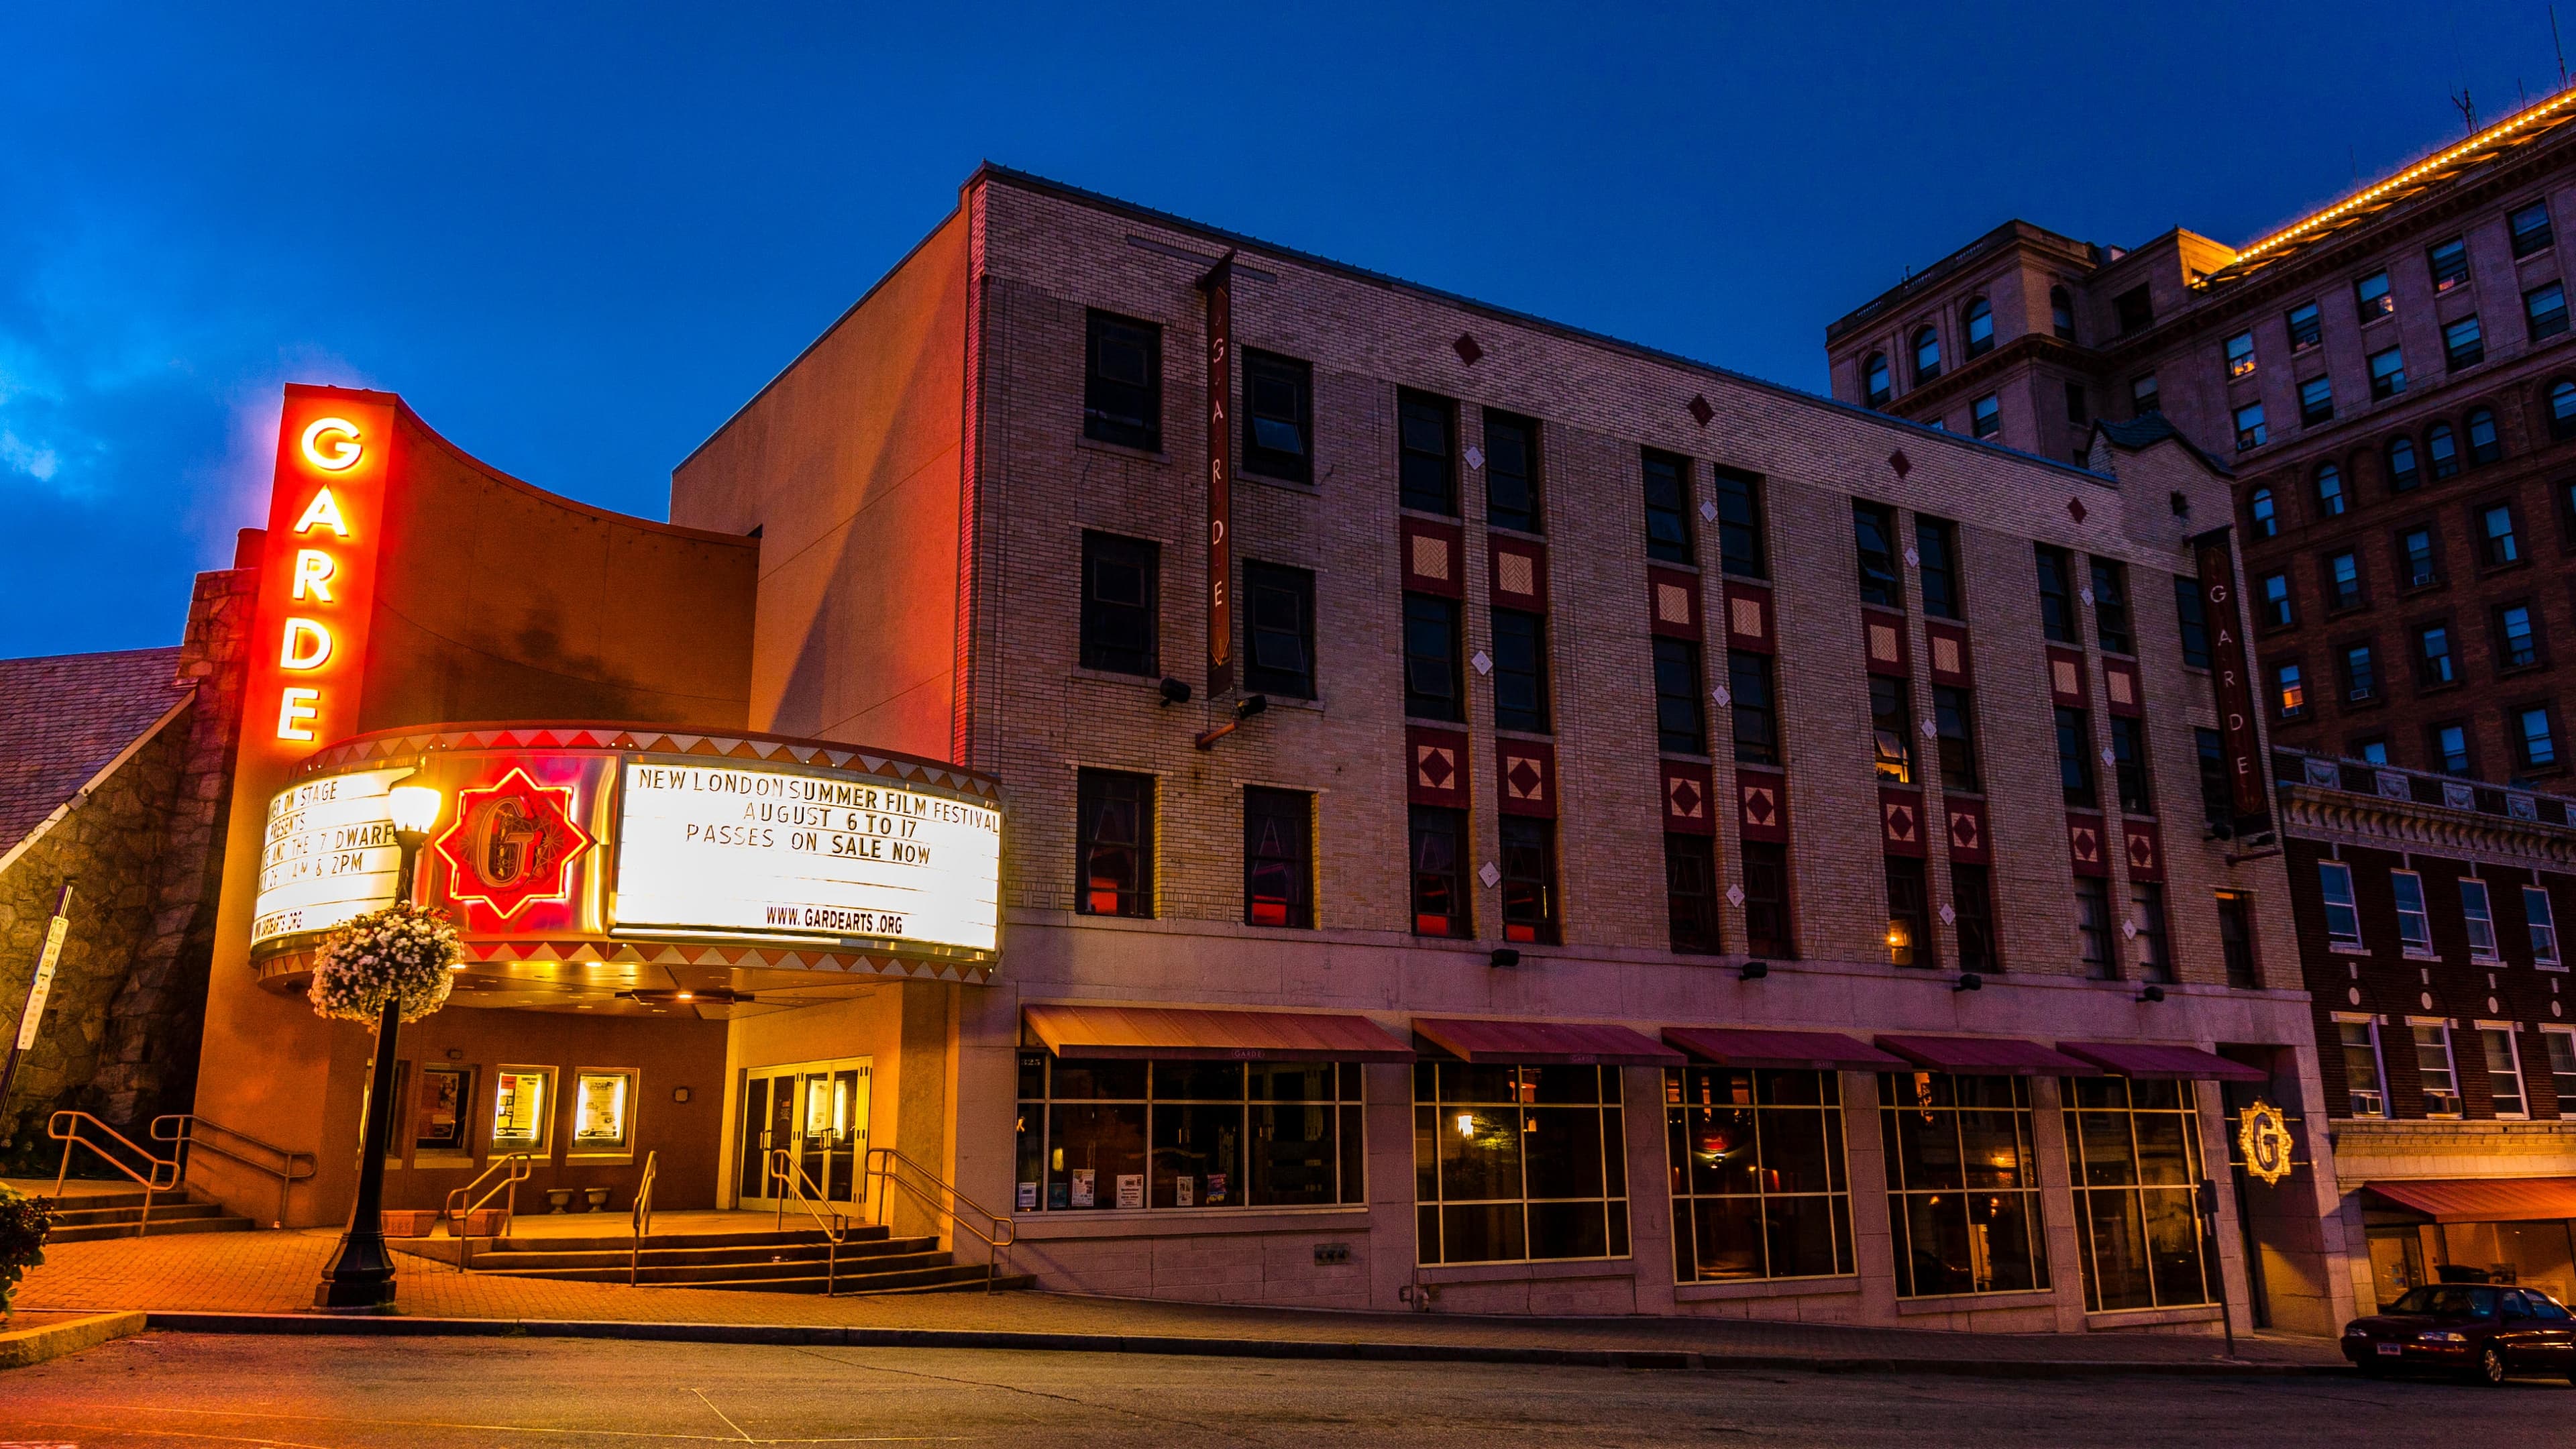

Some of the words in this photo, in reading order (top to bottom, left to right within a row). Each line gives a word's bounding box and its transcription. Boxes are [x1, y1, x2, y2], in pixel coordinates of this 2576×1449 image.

[1212, 337, 1224, 608] GARDE
[276, 417, 362, 742] GARDE
[2210, 585, 2249, 775] GARDE
[301, 781, 337, 806] STAGE
[639, 769, 686, 790] NEW
[694, 771, 784, 797] LONDON
[789, 780, 877, 808] SUMMER
[885, 792, 926, 816] FILM
[934, 800, 998, 833] FESTIVAL
[292, 836, 309, 856] THE
[319, 833, 327, 852] 7
[686, 824, 774, 848] PASSES
[792, 832, 817, 851] ON
[832, 835, 881, 859] SALE
[892, 842, 930, 865] NOW
[743, 802, 831, 826] AUGUST
[847, 813, 857, 830] 6
[865, 813, 892, 835] TO
[900, 818, 916, 838] 17
[331, 853, 364, 874] 2PM
[2254, 1112, 2279, 1171] G
